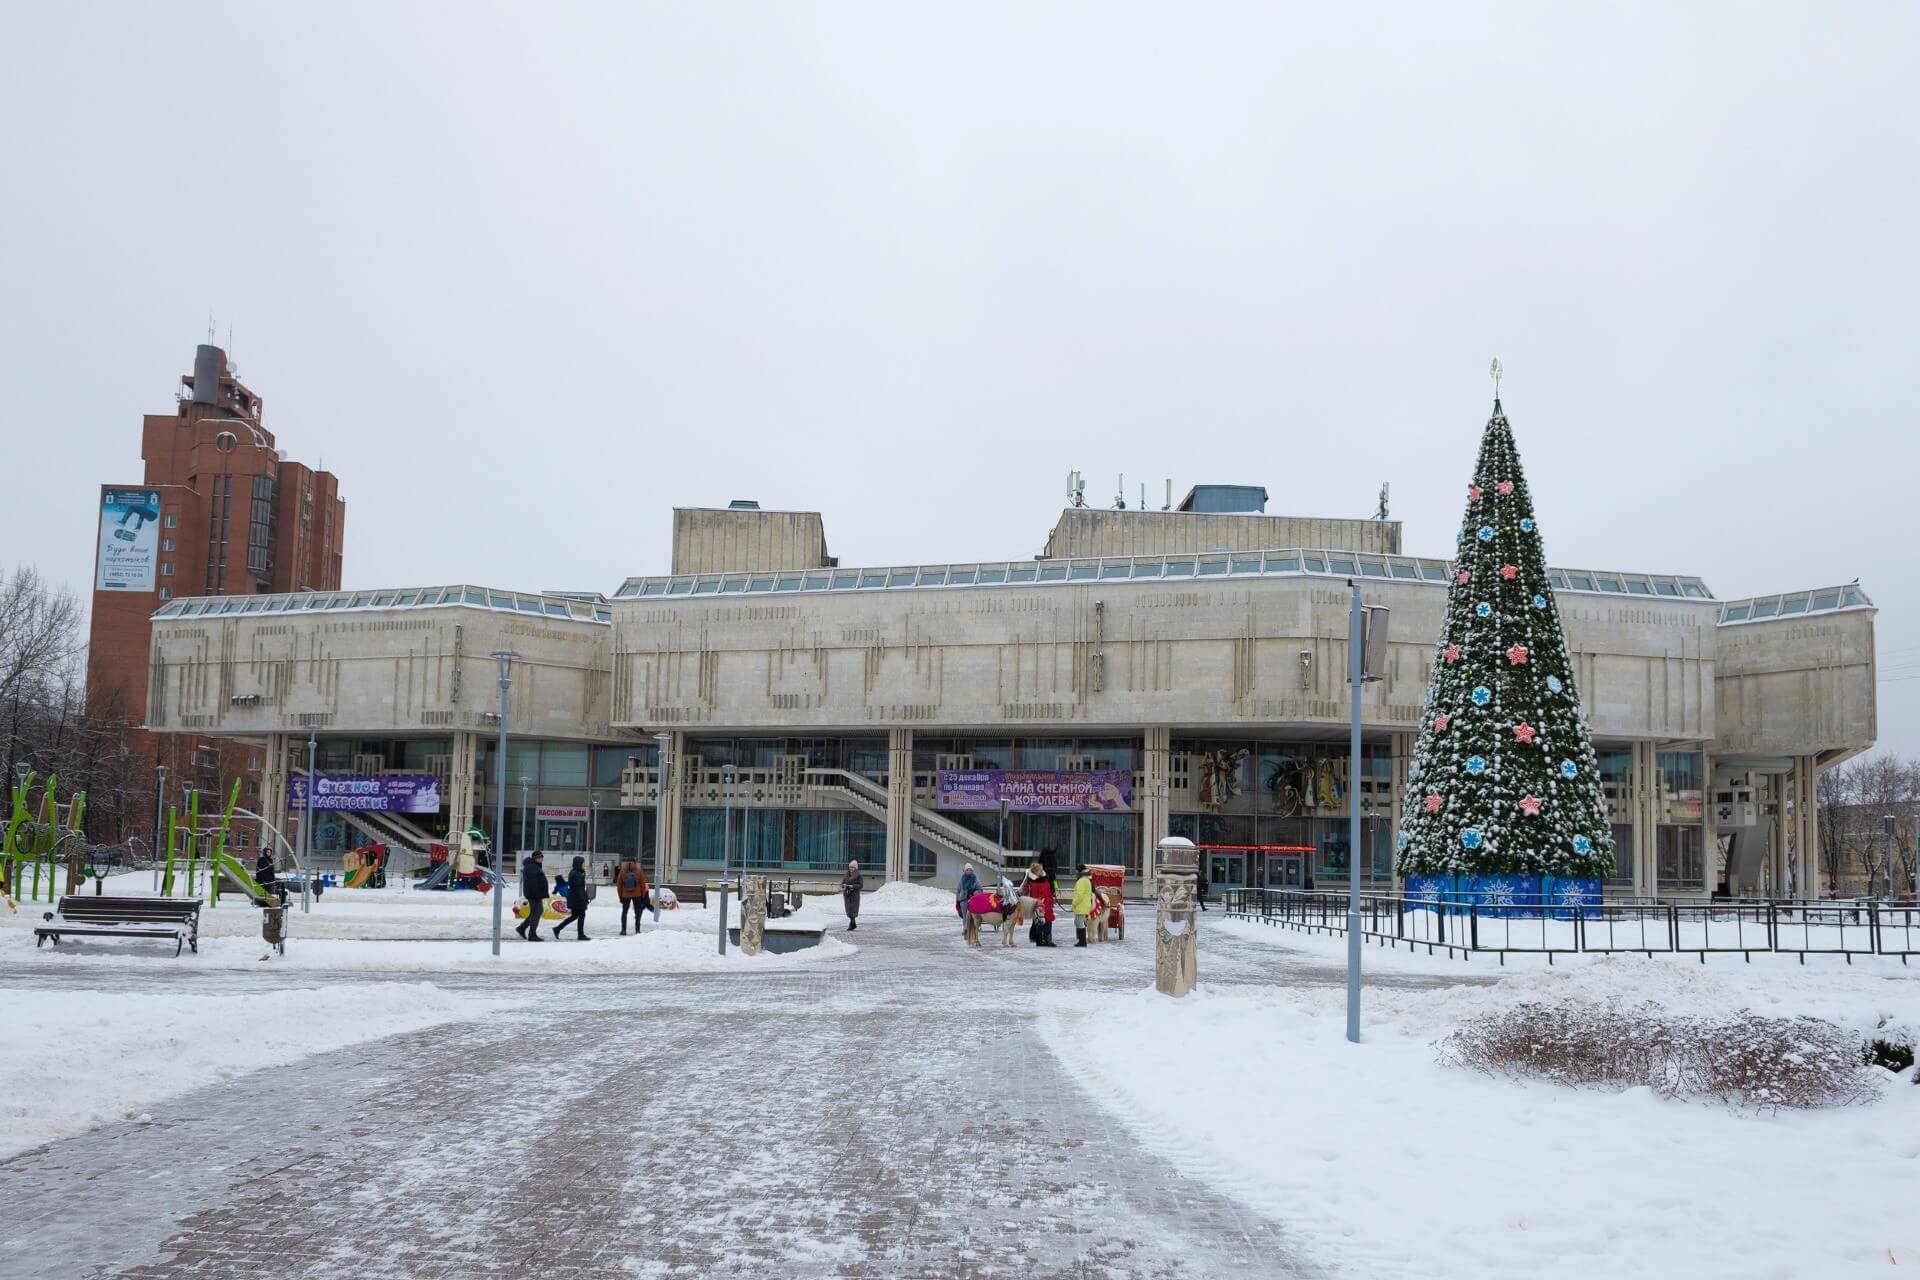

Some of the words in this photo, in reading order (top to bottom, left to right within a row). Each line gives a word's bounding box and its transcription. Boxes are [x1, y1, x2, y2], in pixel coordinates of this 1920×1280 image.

[999, 781, 1034, 793] ТАЙНА
[1037, 781, 1093, 793] СНЕЖНОЙ
[1015, 795, 1076, 806] КОРОЛЕВЫ
[538, 808, 573, 817] КАССОВЫЙ
